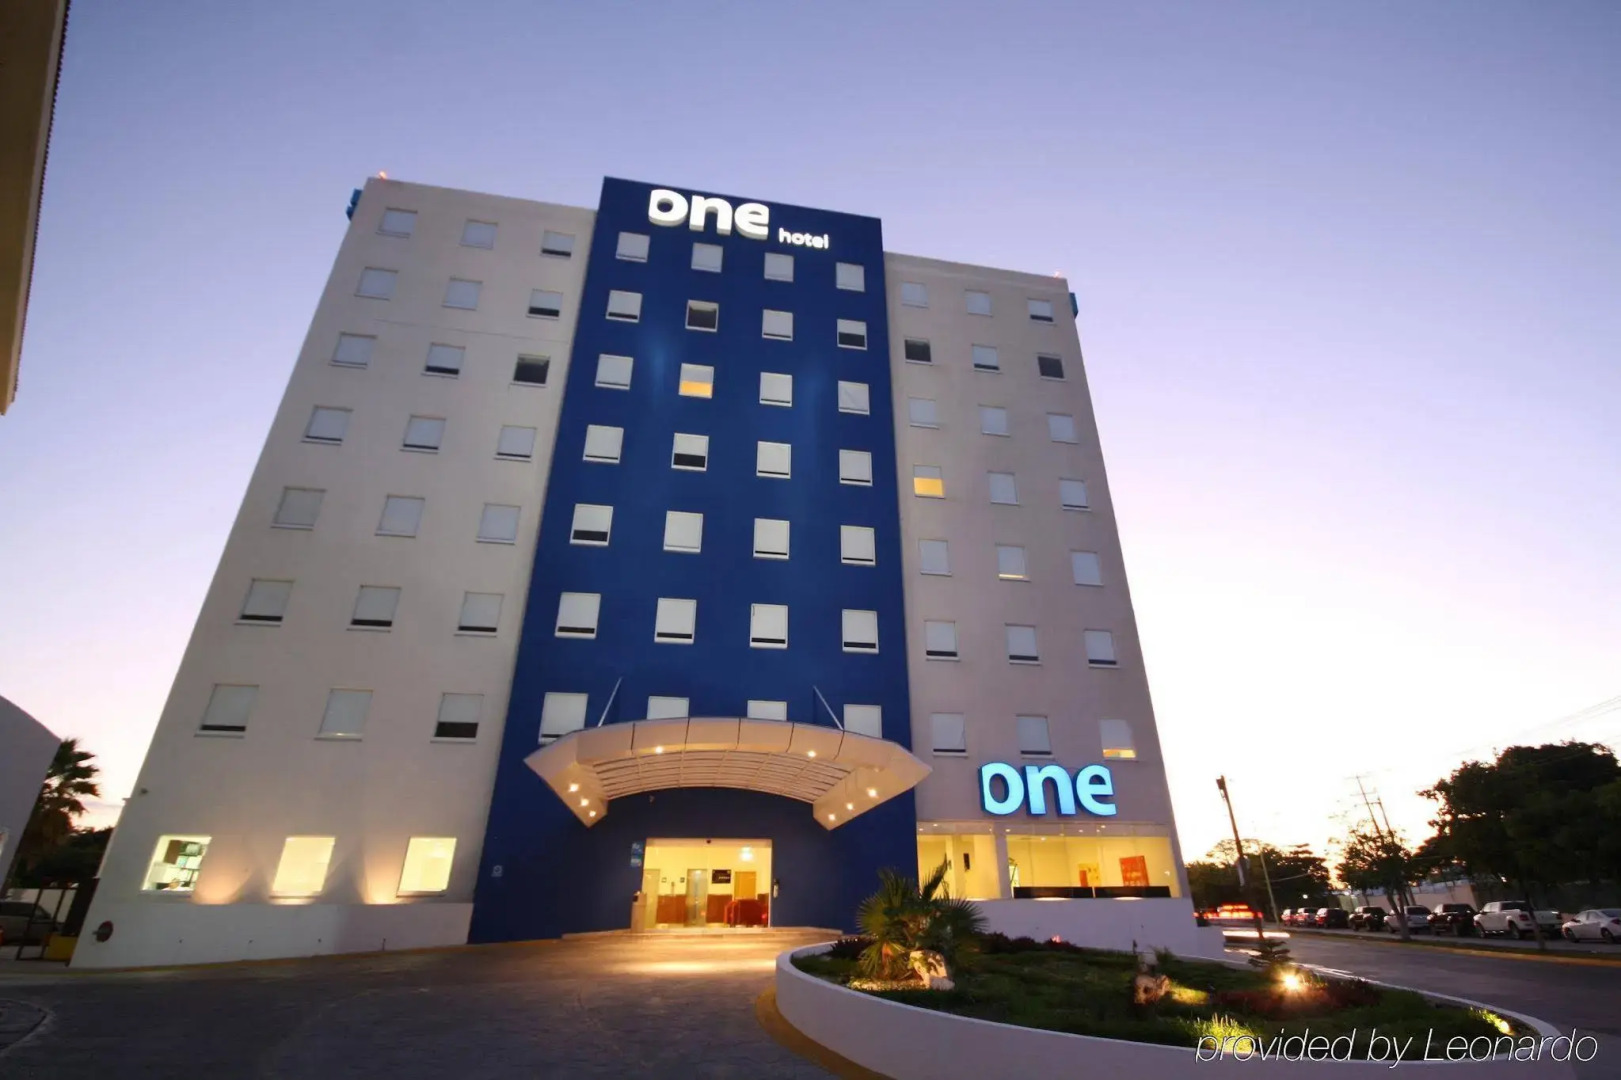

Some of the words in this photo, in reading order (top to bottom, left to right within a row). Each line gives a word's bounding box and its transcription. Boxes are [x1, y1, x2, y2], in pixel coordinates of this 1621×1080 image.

[648, 189, 770, 240] one
[778, 226, 830, 249] hotel
[978, 762, 1117, 817] one
